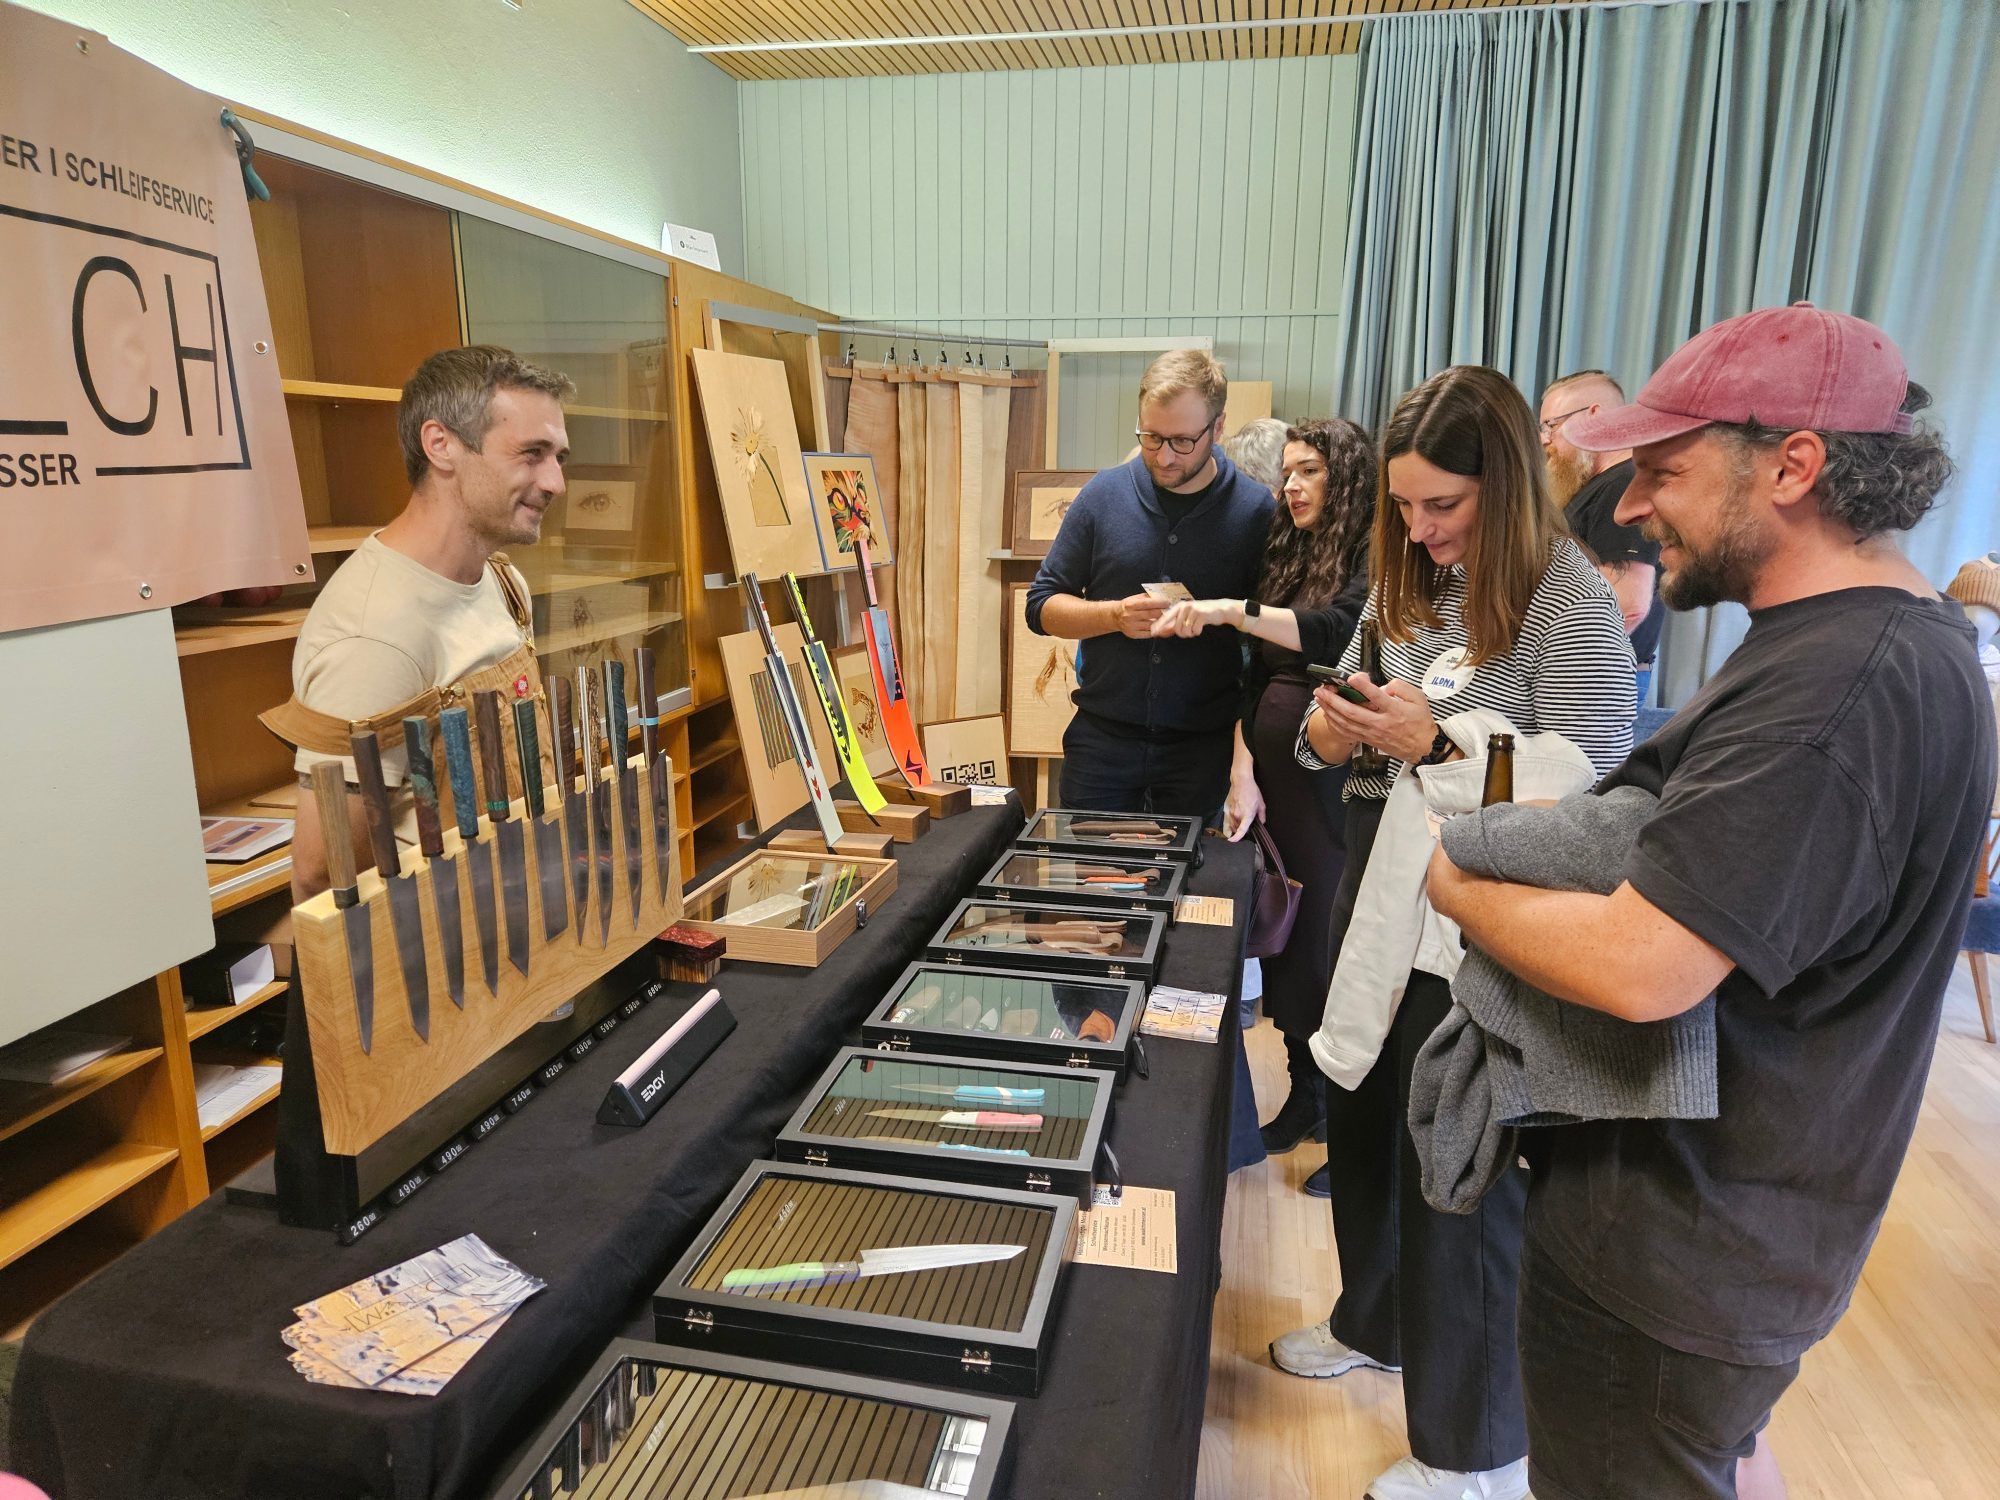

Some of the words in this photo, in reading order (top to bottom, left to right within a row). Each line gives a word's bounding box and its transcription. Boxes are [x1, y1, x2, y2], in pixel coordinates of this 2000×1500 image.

[0, 134, 41, 173] ER
[65, 152, 214, 224] SCHLEIFSERVICE
[0, 453, 80, 488] SSER
[640, 1070, 666, 1103] EDGY
